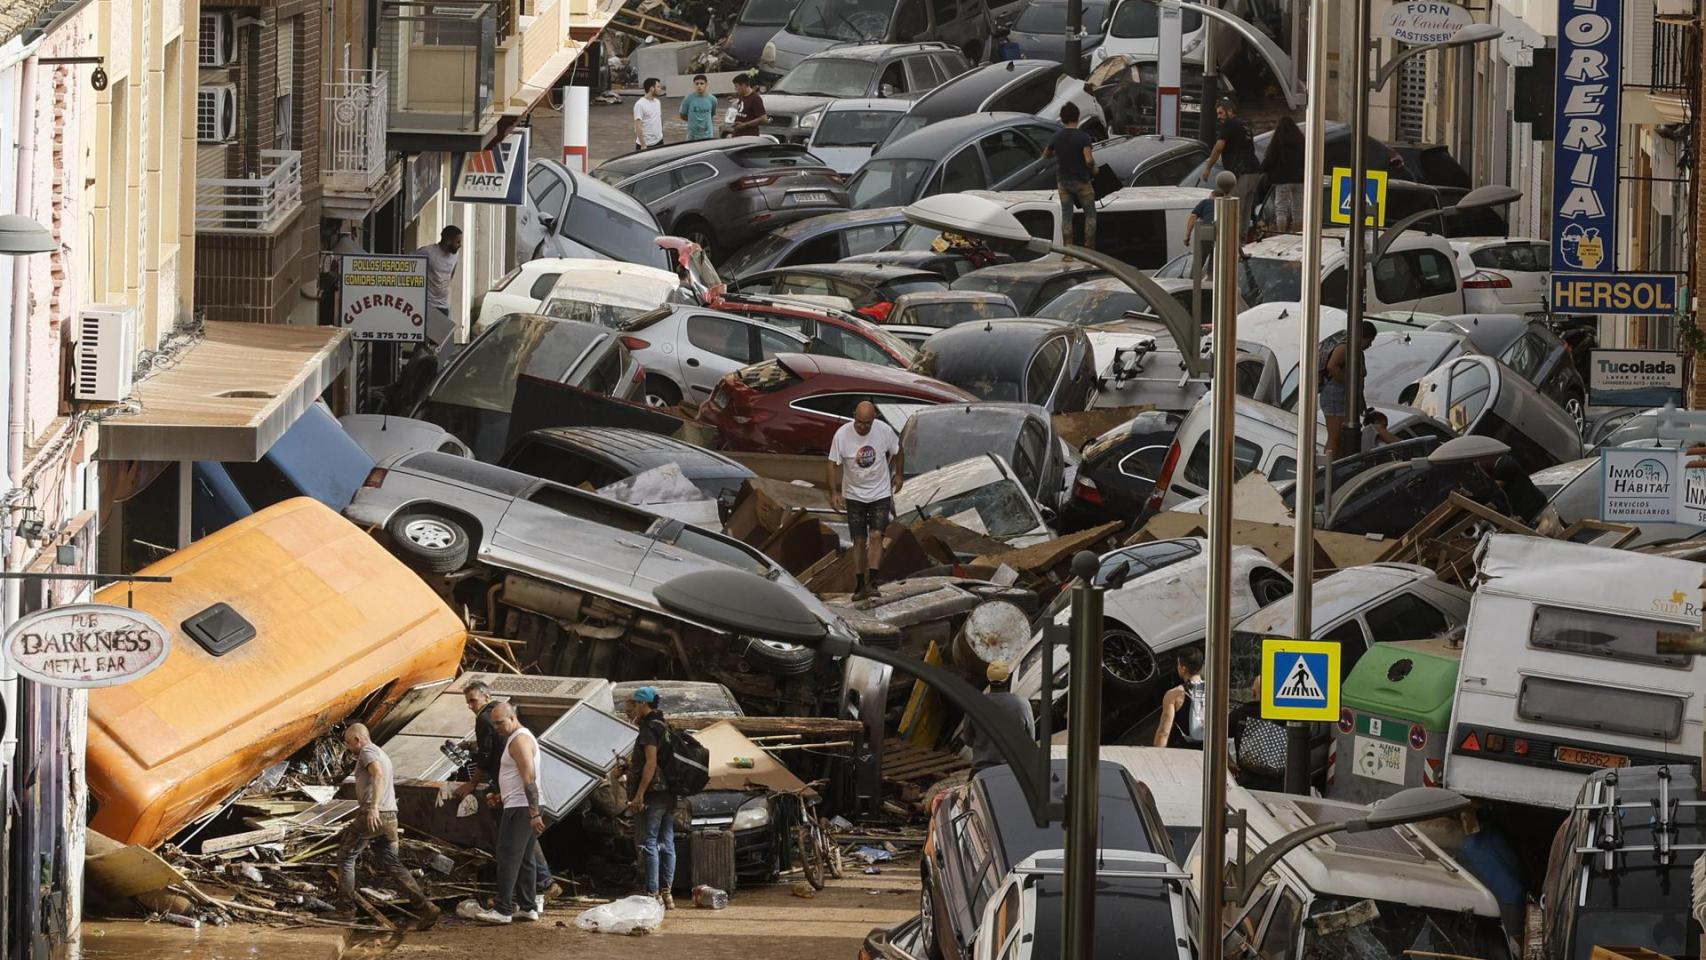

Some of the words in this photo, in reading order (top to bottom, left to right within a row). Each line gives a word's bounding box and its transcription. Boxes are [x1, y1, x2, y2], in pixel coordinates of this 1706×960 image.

[1407, 3, 1450, 16] FORN
[1395, 28, 1456, 42] PASTISSERI
[1559, 0, 1612, 219] ORERIA
[464, 174, 504, 187] FIATC
[352, 259, 380, 271] POLLOS
[381, 260, 410, 272] ASADOS
[410, 261, 417, 272] Y
[344, 274, 376, 286] COMIDAS
[377, 275, 396, 287] PARA
[397, 275, 424, 288] LLEVAR
[1555, 281, 1672, 309] HERSOL
[344, 294, 423, 327] GUERRERO
[1597, 359, 1676, 374] Tucolada
[1609, 464, 1644, 479] INMO
[71, 614, 98, 628] PUB
[21, 628, 151, 656] DARKNESS
[43, 658, 90, 674] METAL
[96, 656, 127, 672] BAR
